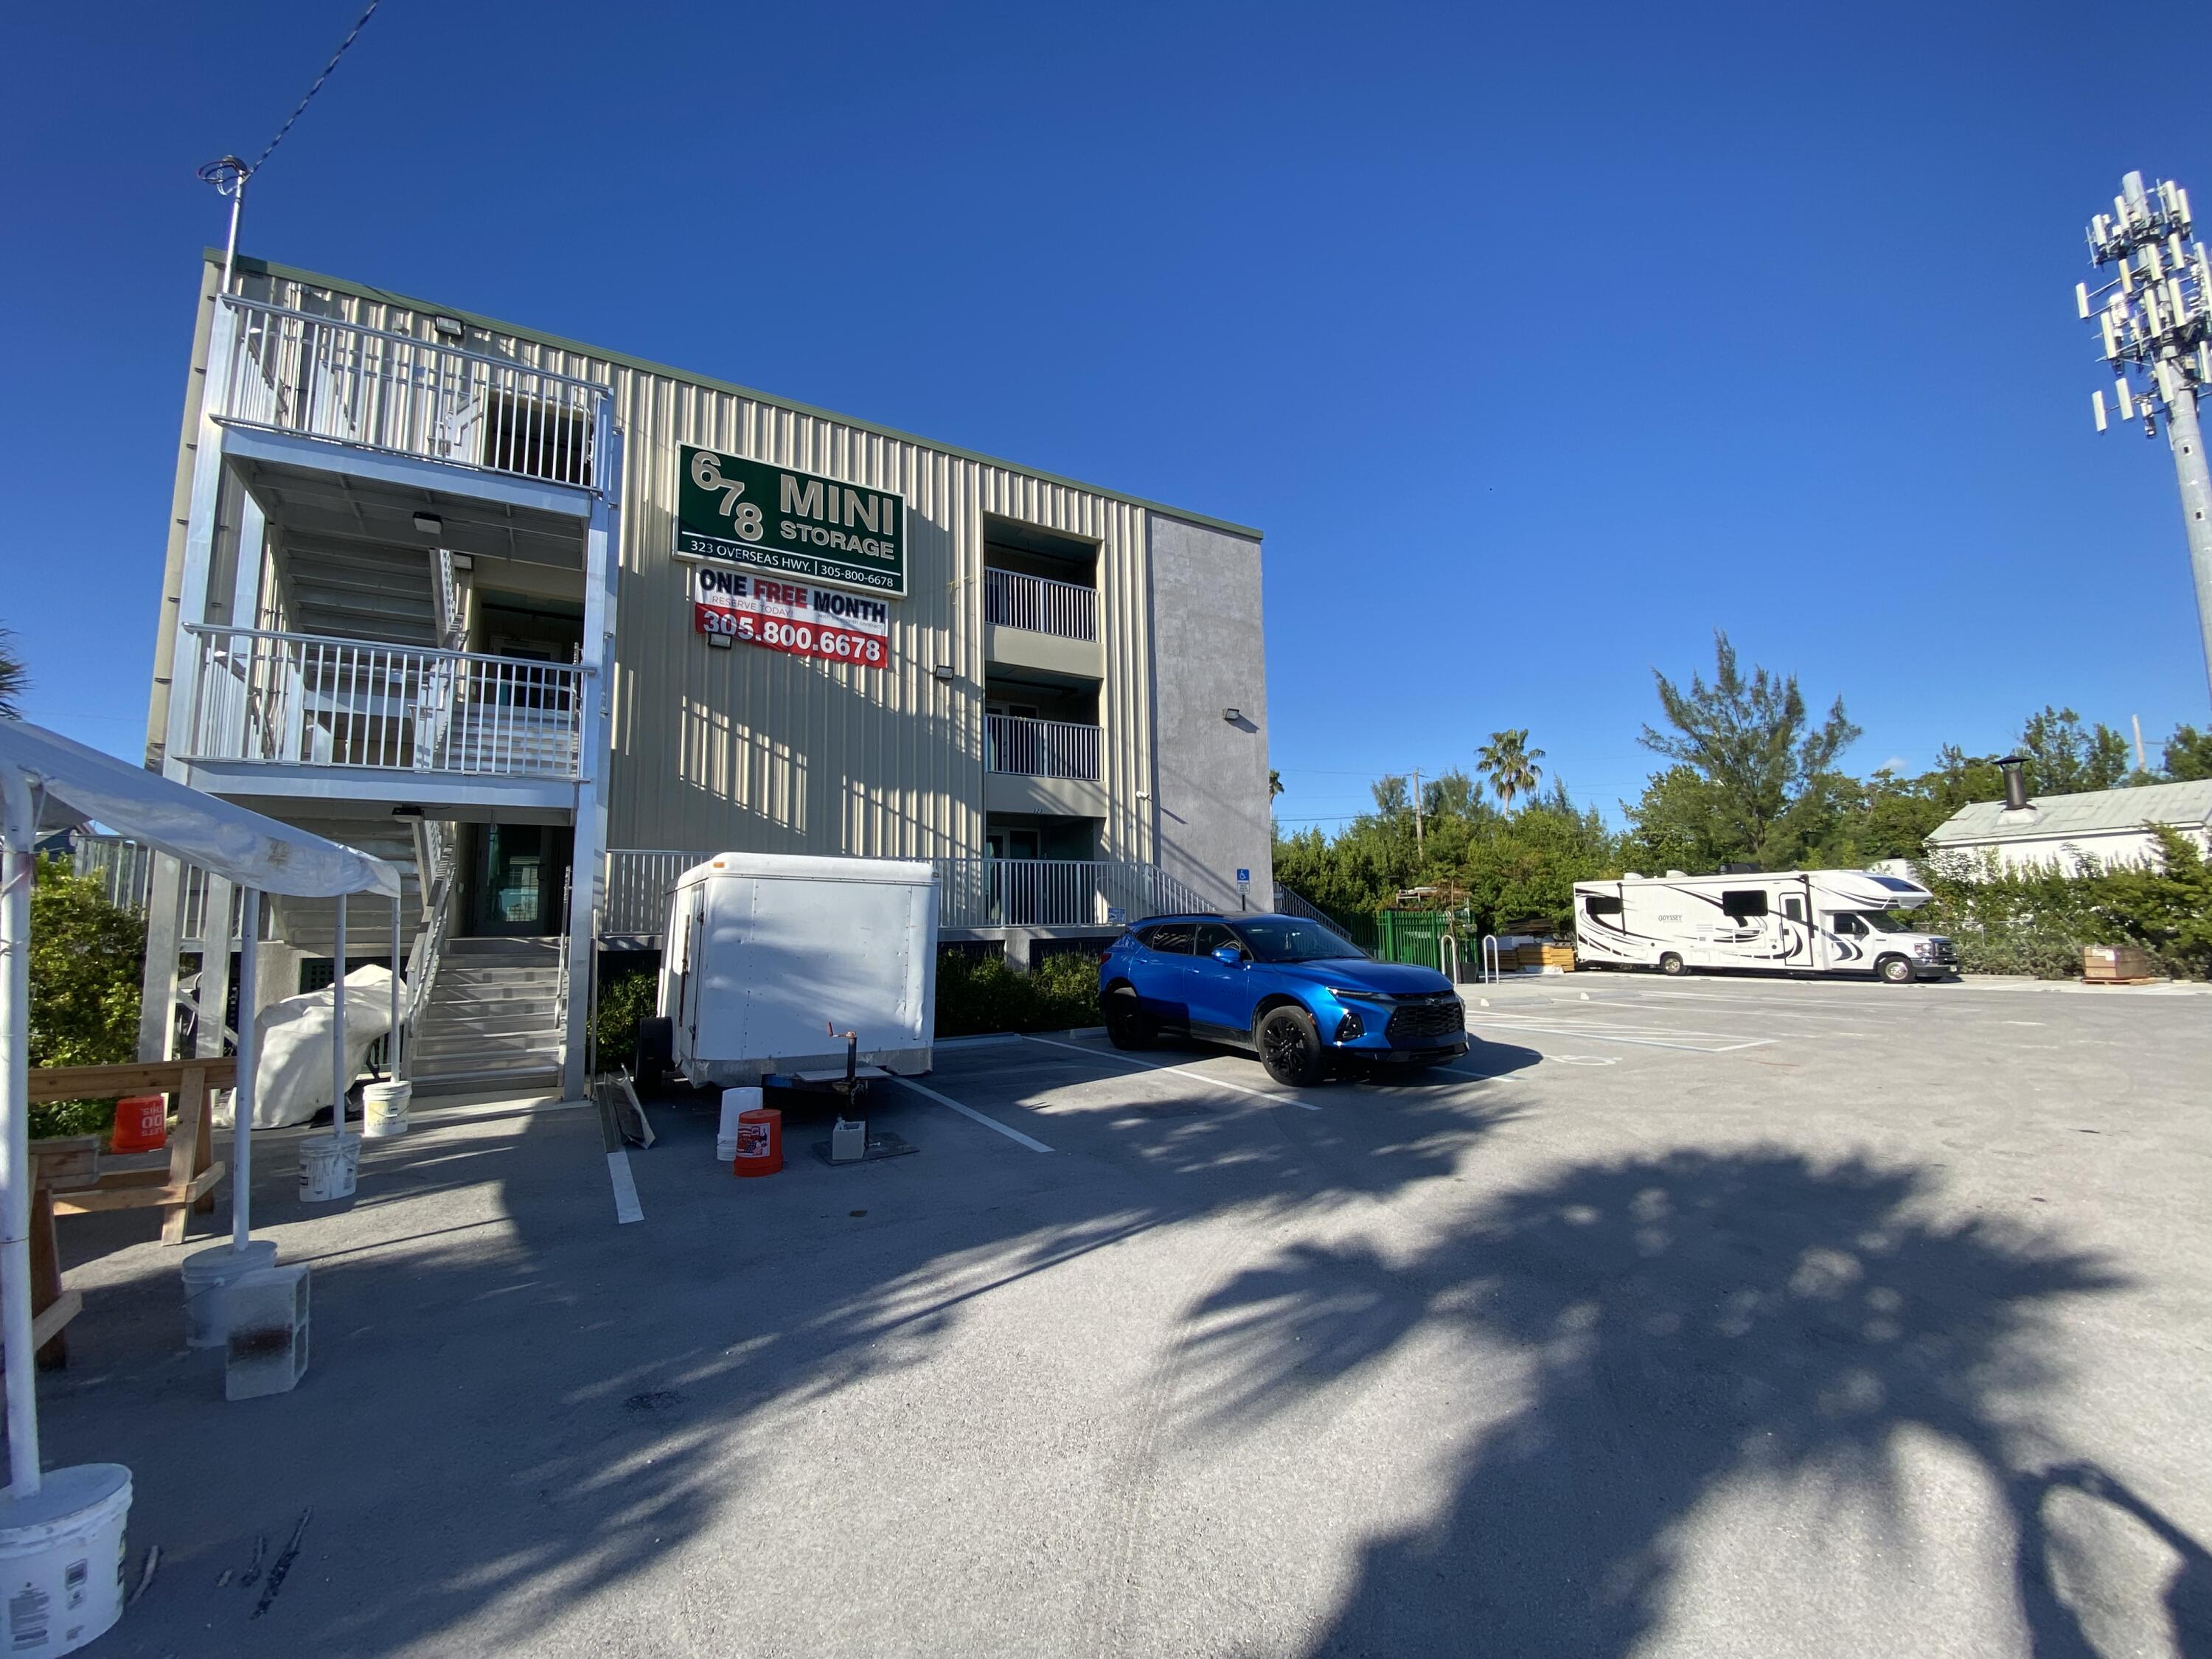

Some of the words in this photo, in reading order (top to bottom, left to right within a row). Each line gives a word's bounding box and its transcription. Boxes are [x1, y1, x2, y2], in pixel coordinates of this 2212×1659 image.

[692, 451, 763, 541] 678
[780, 474, 893, 536] MINI
[690, 540, 714, 554] 323
[717, 546, 779, 566] OVERSEAS
[782, 557, 811, 572] HWY.
[780, 520, 894, 560] STORAGE
[700, 568, 747, 597] ONE
[754, 578, 807, 609] FREE
[813, 591, 885, 624] MONTH
[821, 565, 894, 588] 305-800-6678
[712, 596, 757, 611] RESERVE
[703, 611, 880, 661] 305.800.6678
[142, 1114, 162, 1128] DO
